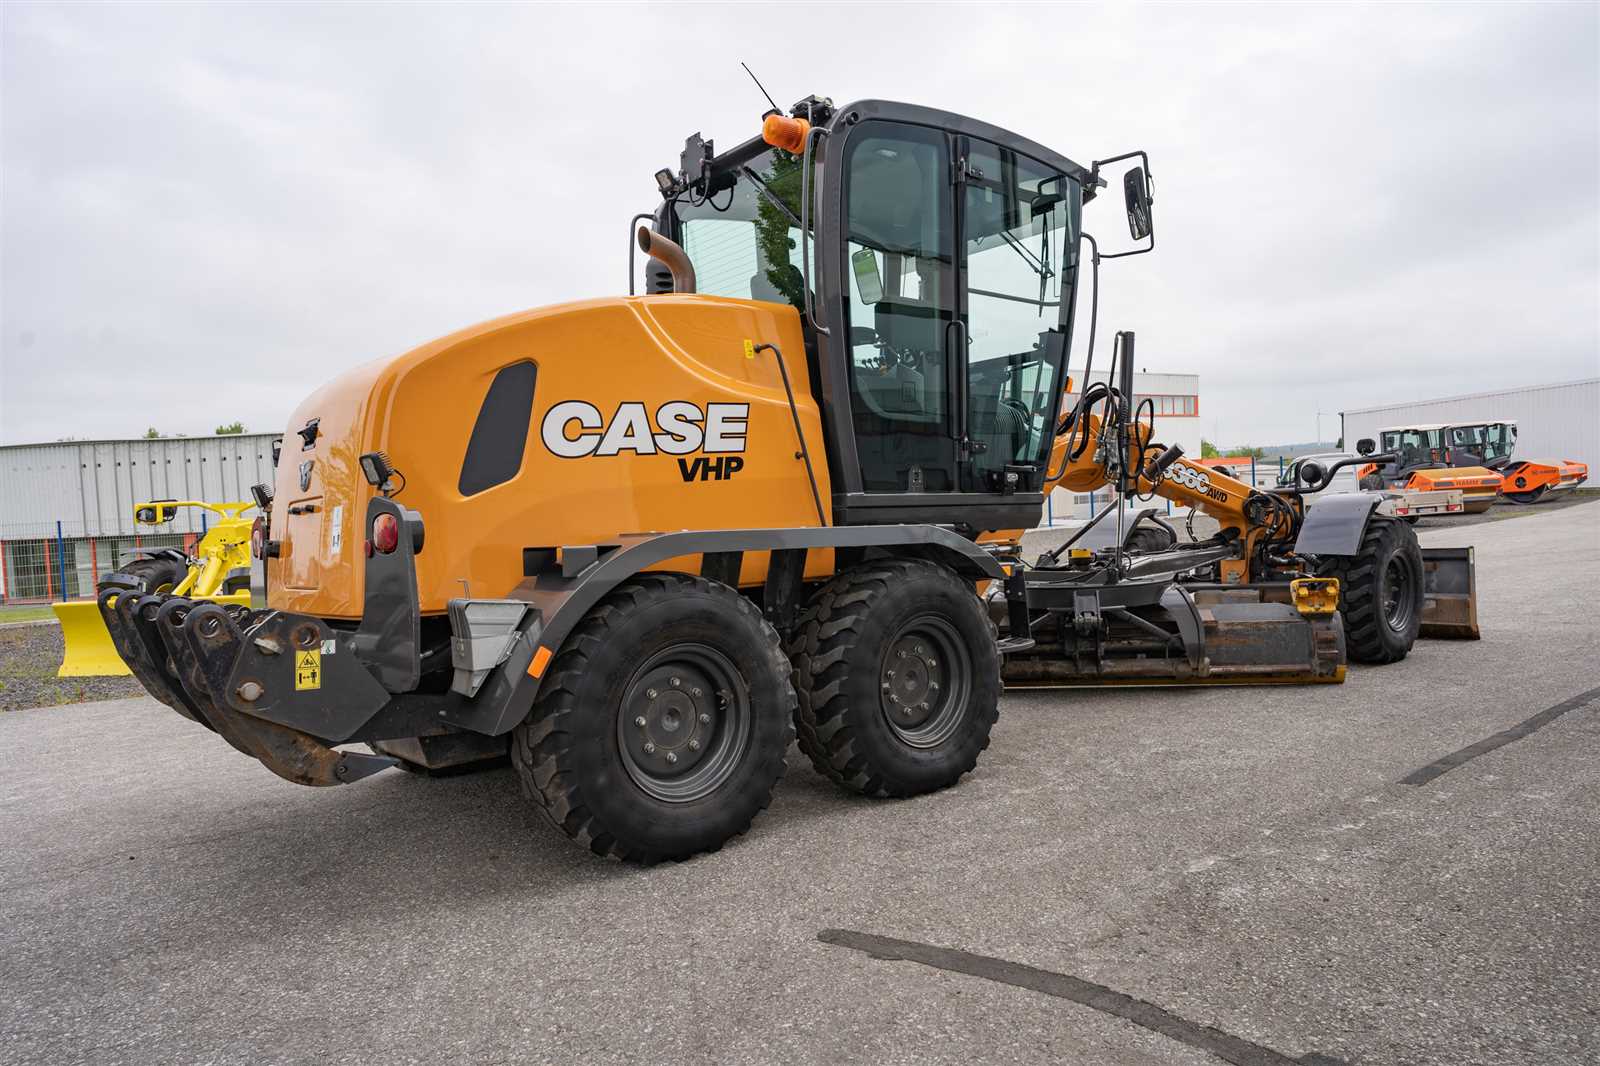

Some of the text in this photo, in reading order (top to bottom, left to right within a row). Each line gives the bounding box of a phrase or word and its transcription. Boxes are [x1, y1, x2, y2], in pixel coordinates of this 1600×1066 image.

[541, 400, 749, 458] CASE
[677, 456, 744, 482] VHP
[1206, 488, 1228, 503] AWD
